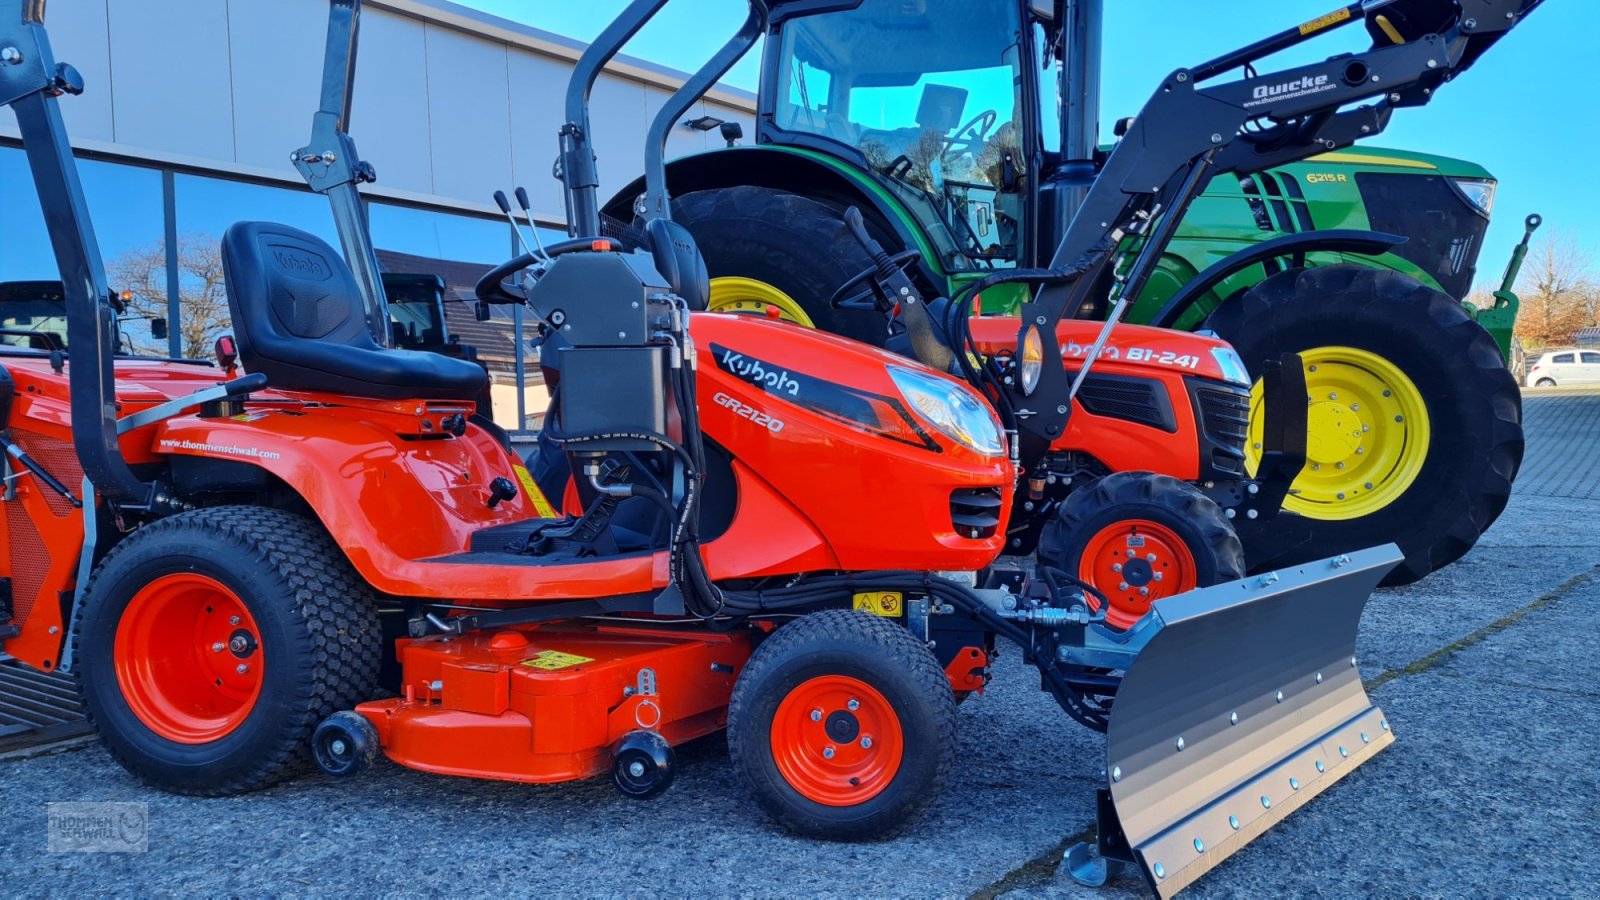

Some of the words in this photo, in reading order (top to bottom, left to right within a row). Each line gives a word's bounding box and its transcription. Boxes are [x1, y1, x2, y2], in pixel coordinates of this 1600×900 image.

[1242, 83, 1337, 108] www.thommenschwall.com
[1253, 75, 1328, 99] Quicke
[1126, 347, 1200, 369] B1-241
[722, 350, 800, 396] Kubota
[712, 392, 785, 433] GR2120
[159, 438, 280, 460] www.thommenschwall.com
